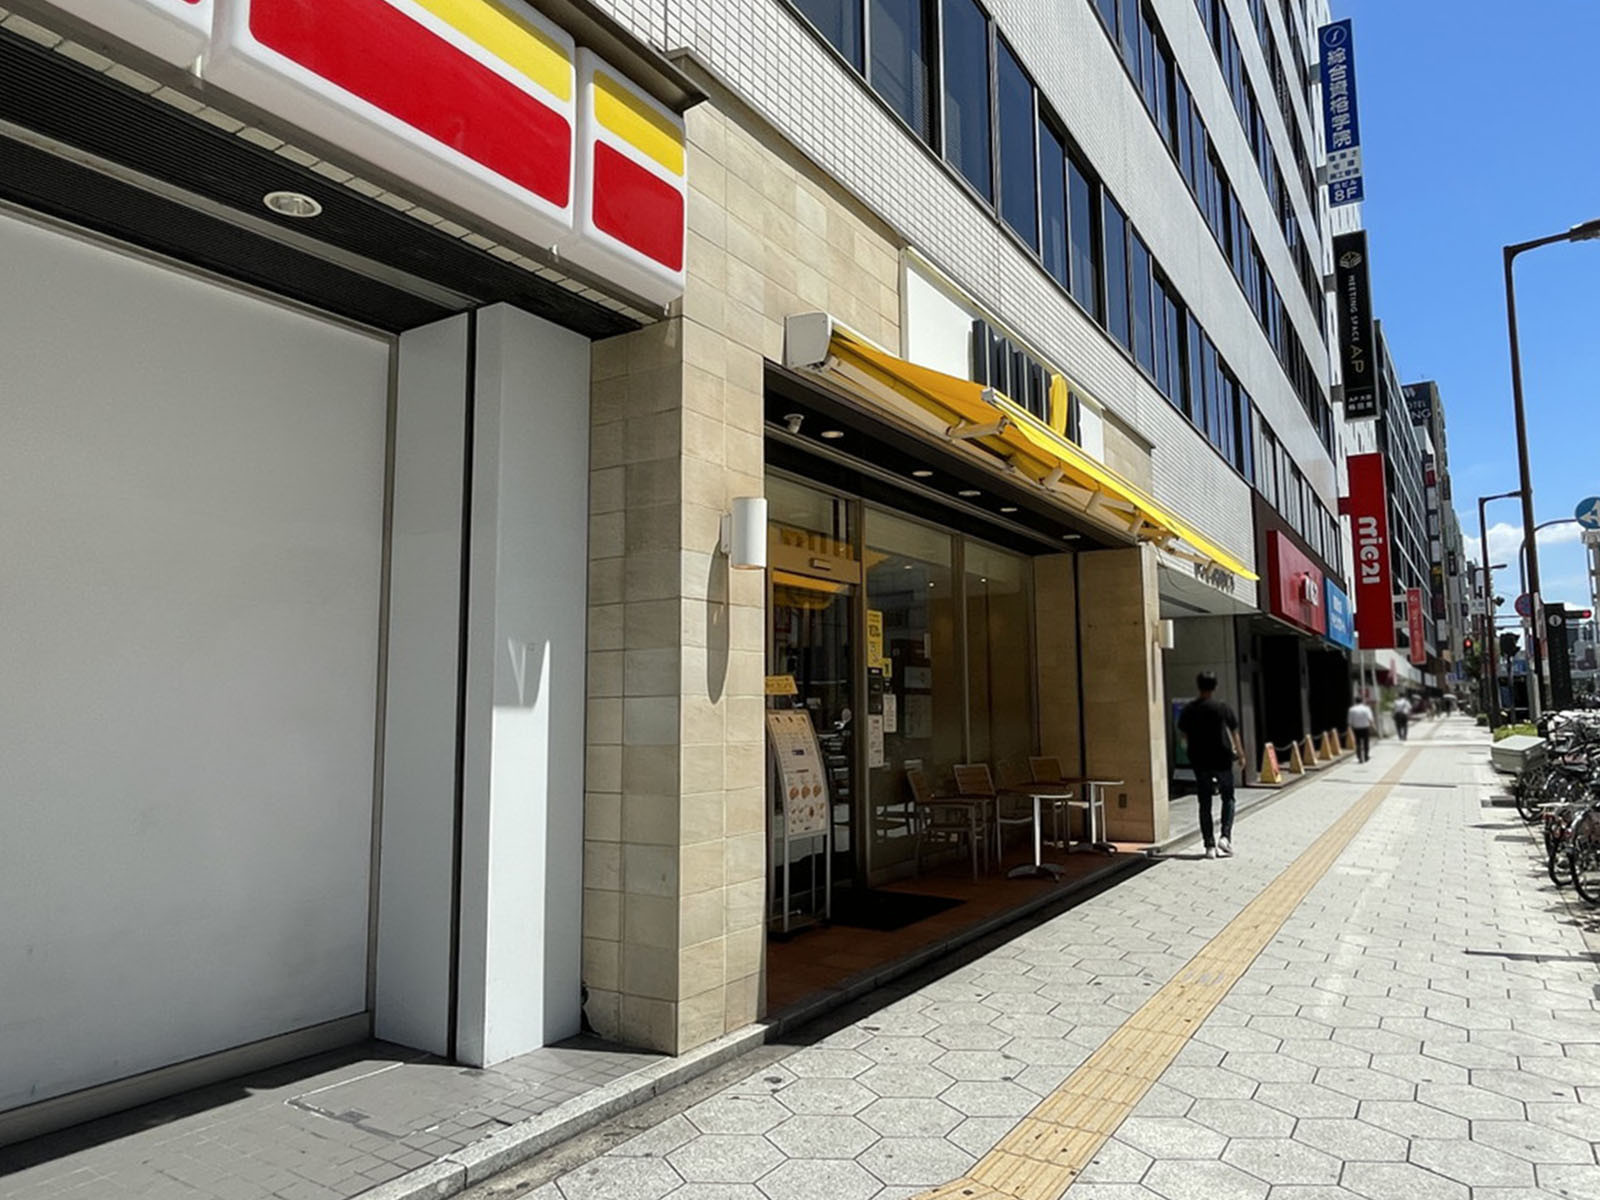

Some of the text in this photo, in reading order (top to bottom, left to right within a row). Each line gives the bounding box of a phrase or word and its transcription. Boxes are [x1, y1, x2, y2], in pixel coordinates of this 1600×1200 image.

[1334, 186, 1358, 202] 8F
[1348, 275, 1358, 313] MEETING
[1350, 346, 1364, 373] AP
[1358, 516, 1383, 584] mic21
